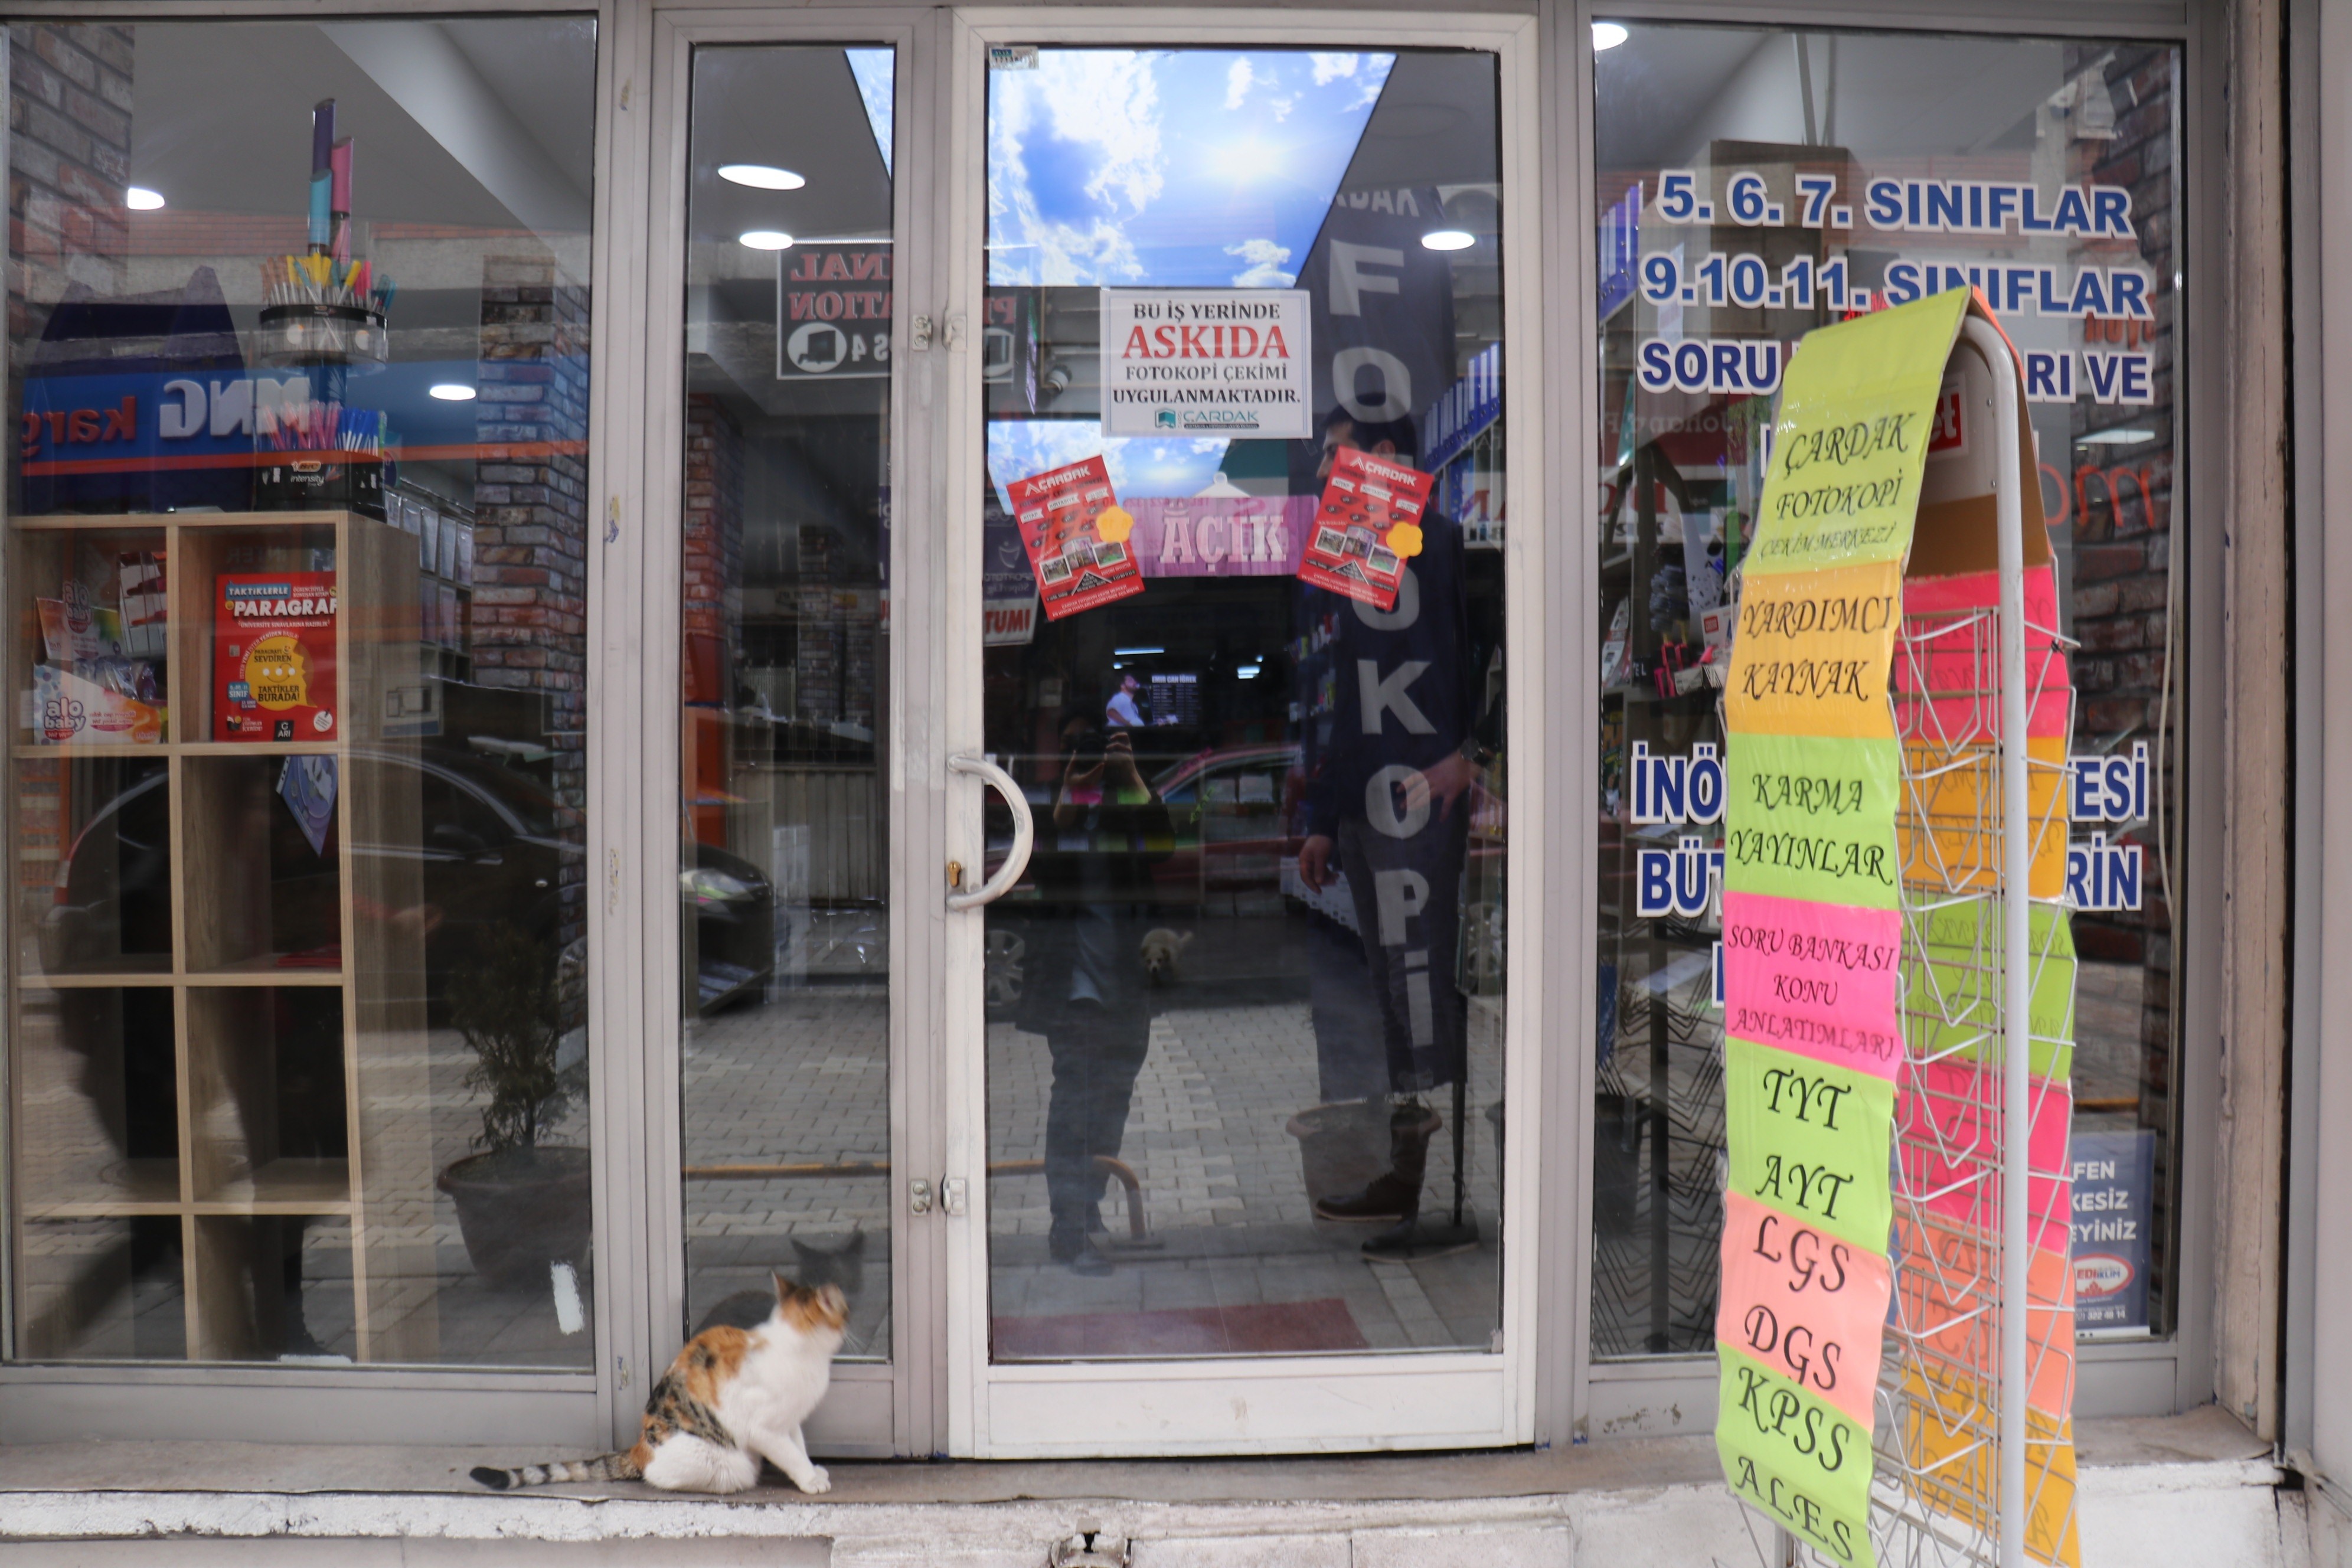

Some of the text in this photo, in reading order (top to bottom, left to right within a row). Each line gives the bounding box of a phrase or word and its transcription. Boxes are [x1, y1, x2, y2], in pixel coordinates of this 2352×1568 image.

[1657, 168, 2137, 240] 5. 6. 7. SINIFLAR
[1133, 300, 1280, 323] BU İŞ YERİNDE
[1882, 259, 2155, 322] SINIFLAR
[1122, 325, 1291, 359] ASKIDA
[1126, 363, 1288, 383] FOTOKOPİ ÇEKİMİ
[1636, 337, 1783, 396] SORU
[2081, 349, 2155, 406] VE
[1113, 388, 1301, 404] UYGULANMAKTADIR.
[1784, 413, 1916, 479] ÇARDAK
[290, 475, 325, 487] intensity
[1776, 468, 1904, 520] FOTOKOPİ
[1159, 509, 1288, 573] AÇIK
[1760, 521, 1897, 560] ÇEKİM MERKEZİ
[234, 598, 337, 617] PARAGRAF
[1743, 596, 1893, 639] YARDIMCI
[254, 653, 292, 663] SEVDİREN
[1742, 658, 1869, 701] KAYNAK
[46, 696, 84, 718] alo
[257, 693, 300, 703] BURADA!
[258, 684, 300, 695] TAKTİKLER
[44, 715, 87, 732] baby
[1752, 773, 1863, 815] KARMA
[1730, 828, 1893, 887] YAYINLAR
[1727, 925, 1785, 957] SORU
[1788, 933, 1895, 972] BANKASI
[1773, 974, 1838, 1006] KONU
[1732, 1007, 1894, 1061] ANLATIMLARI
[1763, 1069, 1852, 1131] TYT
[1755, 1154, 1854, 1220] AYT
[1753, 1215, 1850, 1293] LGS
[1744, 1304, 1841, 1391] DGS
[1737, 1366, 1850, 1473] KPSS
[1735, 1455, 1854, 1562] ALES
